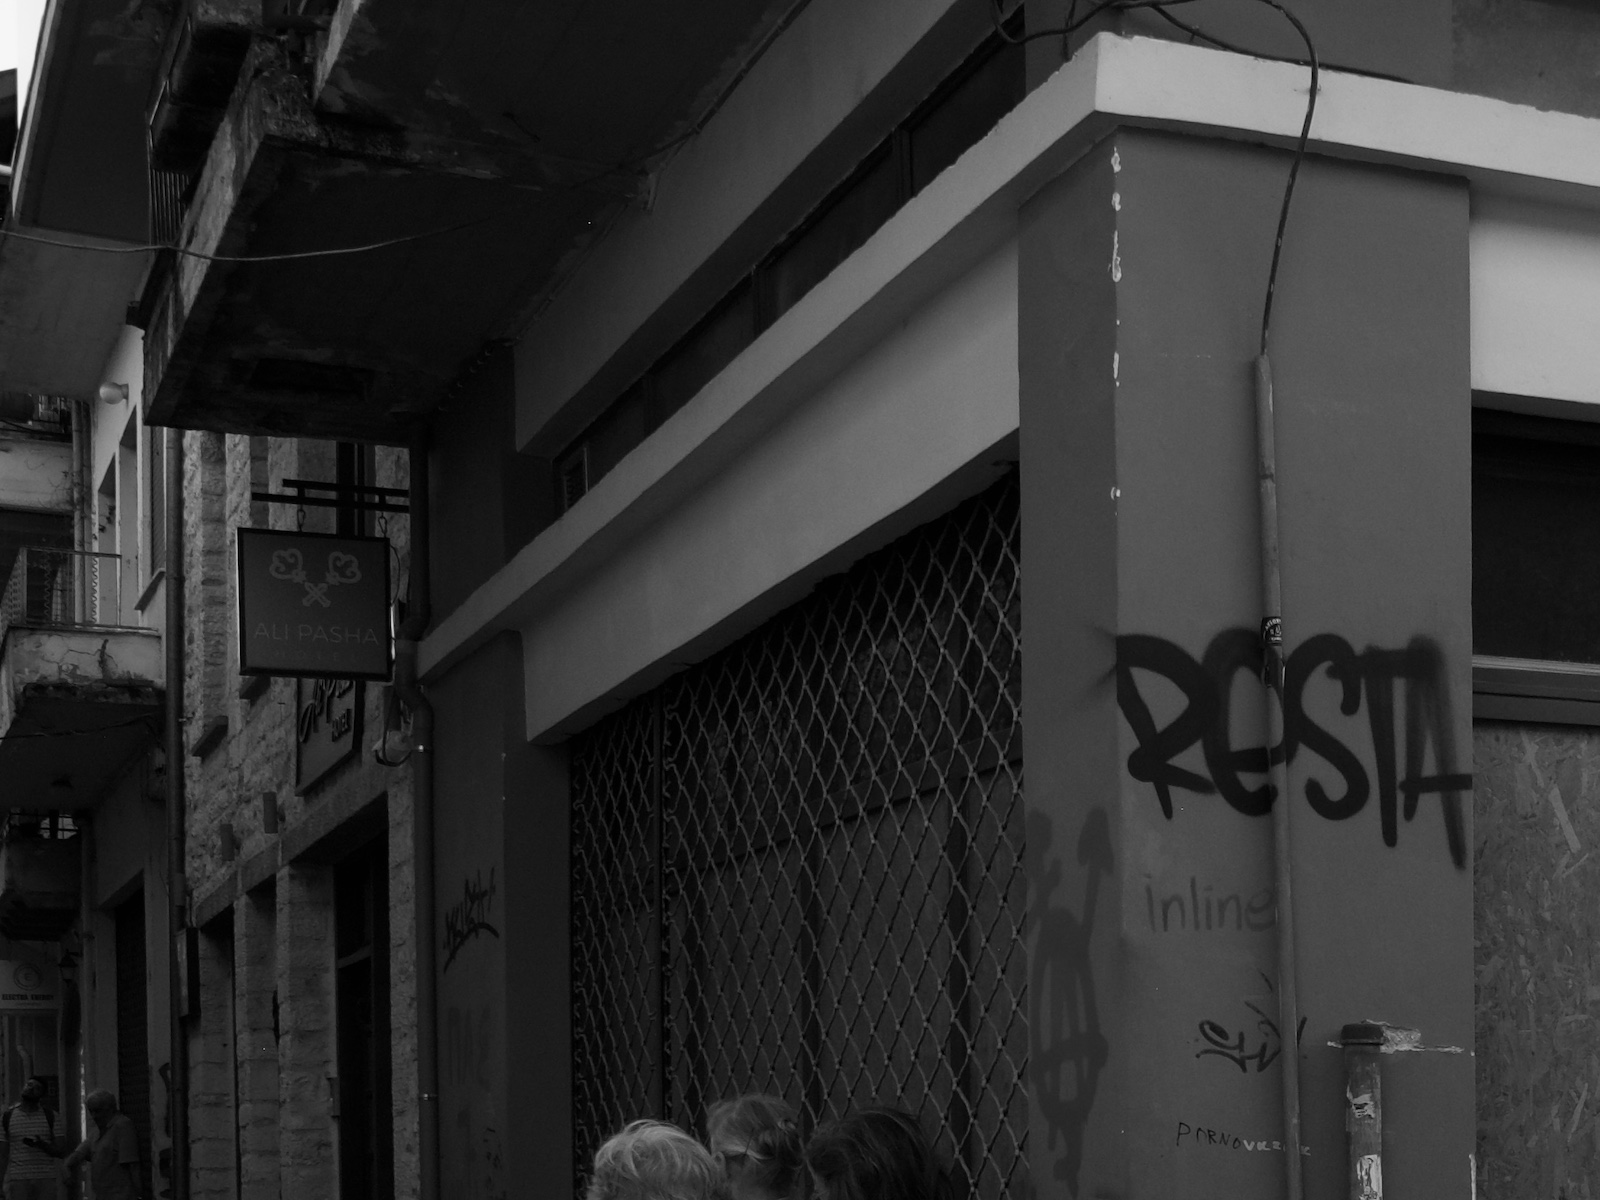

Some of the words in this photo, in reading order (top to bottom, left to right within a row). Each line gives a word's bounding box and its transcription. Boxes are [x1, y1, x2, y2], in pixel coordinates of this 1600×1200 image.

[253, 621, 289, 641] ALI
[298, 623, 380, 646] PASHA
[1143, 873, 1277, 932] inline
